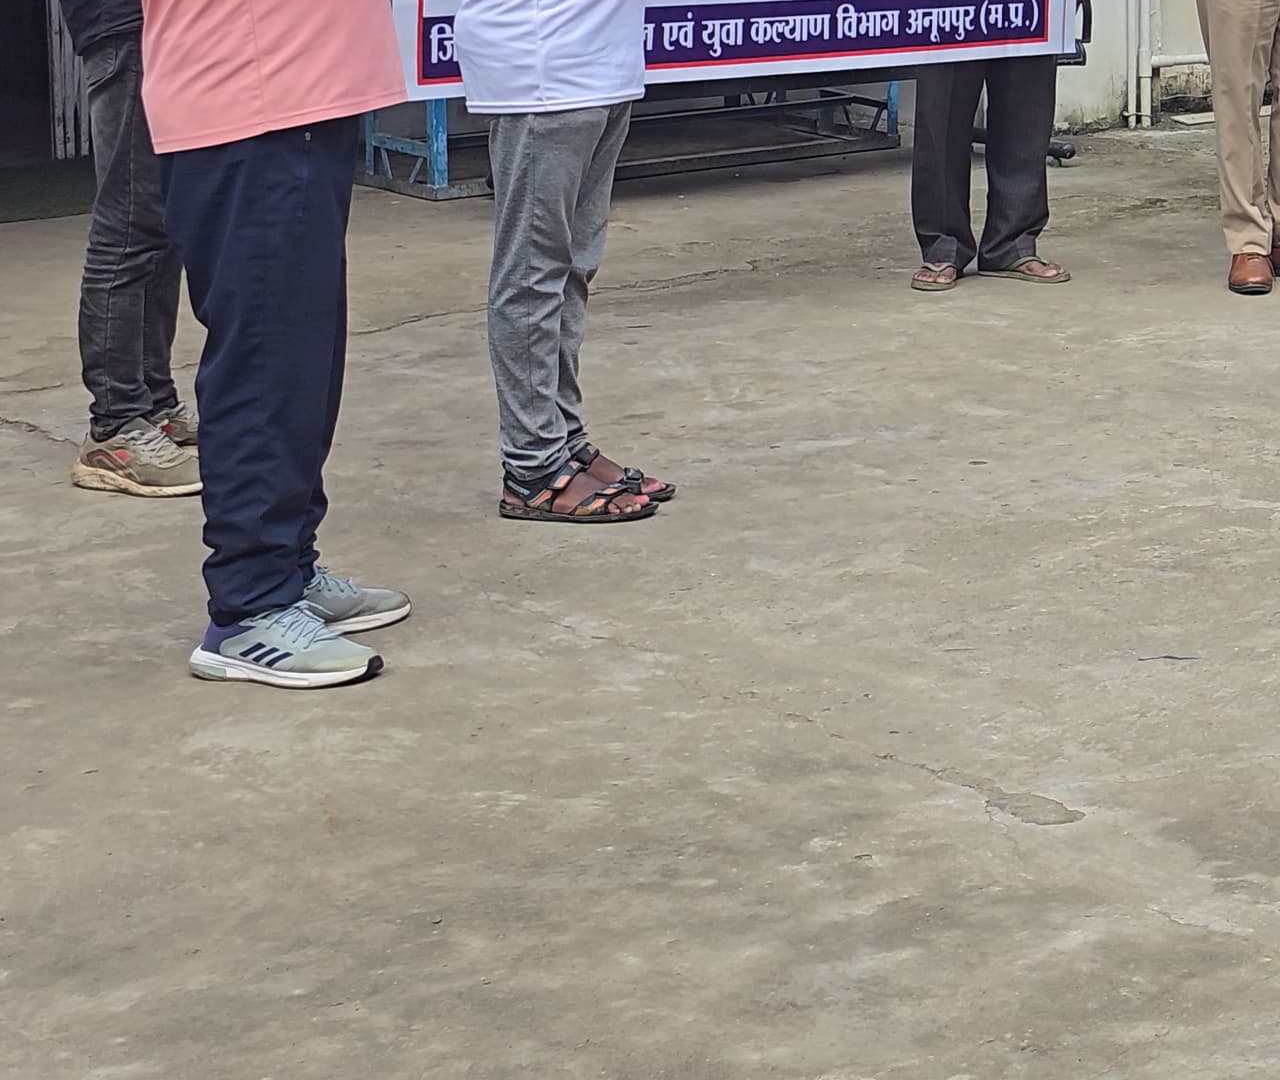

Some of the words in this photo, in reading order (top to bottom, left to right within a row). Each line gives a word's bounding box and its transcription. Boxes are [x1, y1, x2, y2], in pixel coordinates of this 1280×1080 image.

[662, 12, 696, 52] एवं
[702, 19, 745, 57] युवा
[750, 14, 831, 44] कल्याण
[836, 4, 900, 39] विभाग
[905, 5, 976, 43] अनूपपुर
